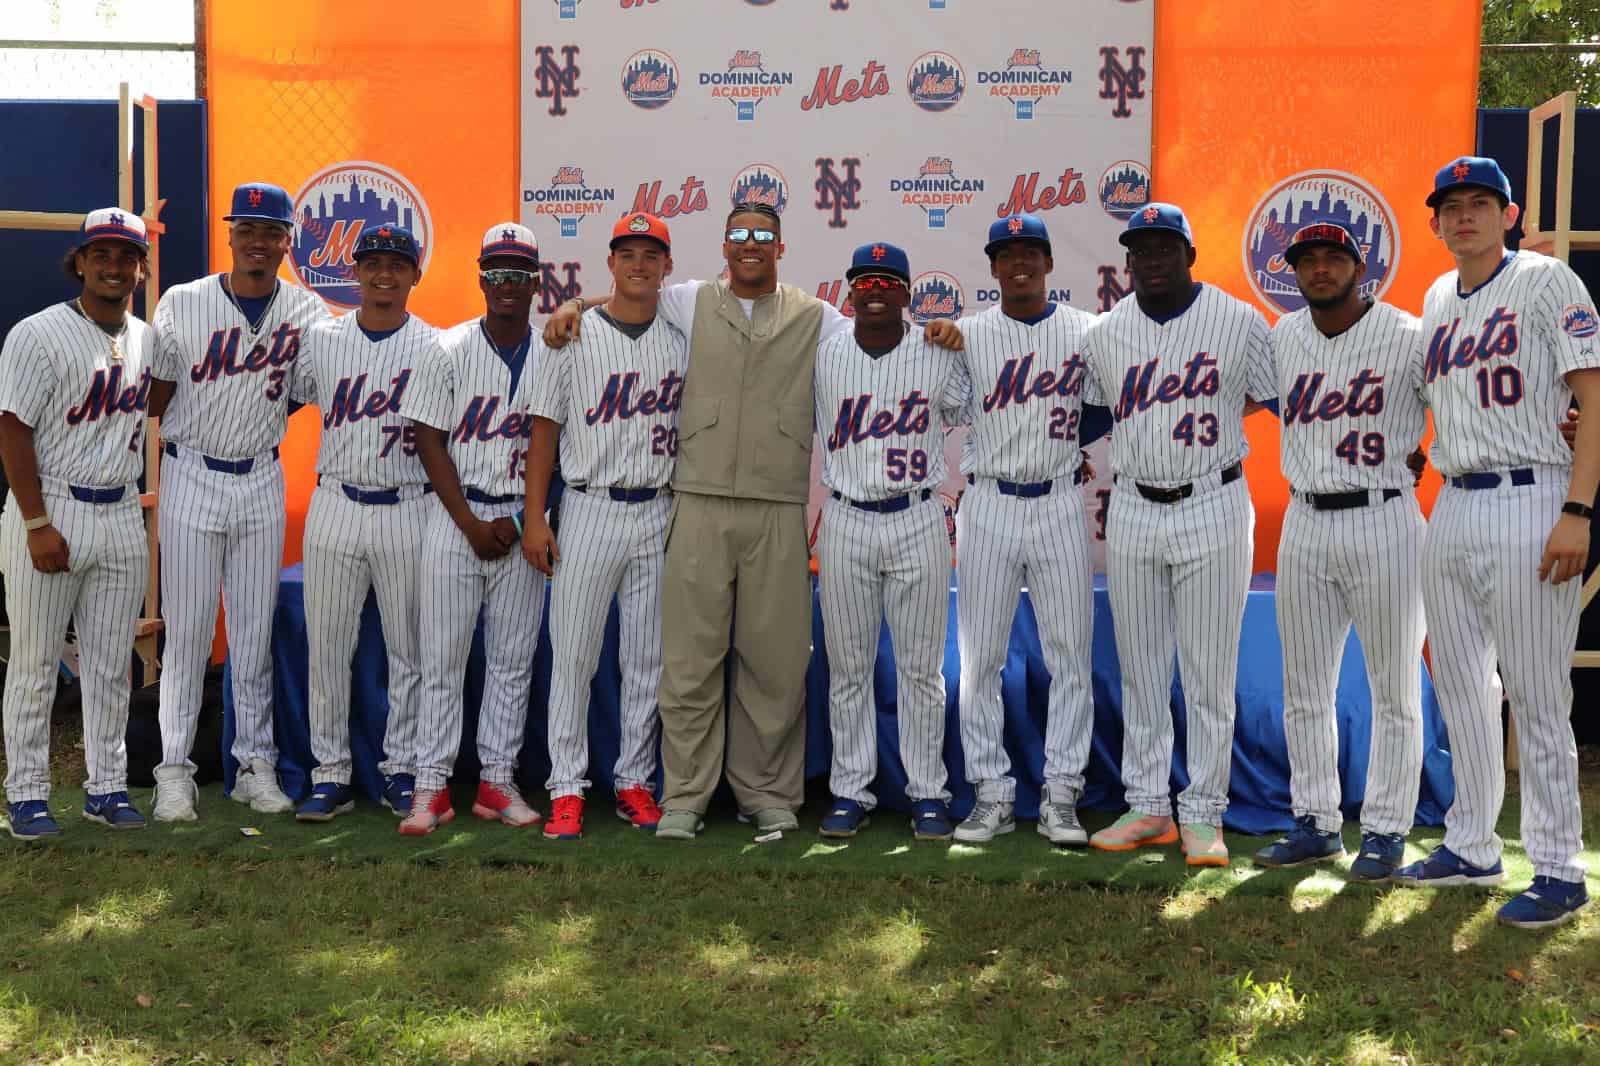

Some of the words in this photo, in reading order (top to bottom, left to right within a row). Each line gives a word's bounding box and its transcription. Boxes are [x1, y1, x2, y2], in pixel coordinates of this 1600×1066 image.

[699, 72, 793, 85] DOMINICAN
[711, 86, 782, 98] ACADEMY
[800, 61, 890, 111] Mets
[977, 70, 1072, 84] DOMINICAN
[989, 85, 1062, 97] ACADEMY
[523, 188, 615, 202] DOMINICAN
[620, 176, 709, 218] Mets
[890, 179, 984, 192] DOMINICAN
[902, 193, 973, 205] ACADEMY
[997, 168, 1086, 217] Mets
[535, 202, 604, 215] ACADEMY
[191, 322, 301, 383] Mets
[1425, 307, 1518, 384] Mets
[66, 364, 152, 425] Met
[266, 370, 287, 404] 3
[324, 368, 413, 431] Met
[1114, 352, 1219, 424] Mets
[1284, 369, 1384, 427] Mets
[1476, 365, 1524, 409] 10
[827, 390, 930, 452] Mets
[1049, 407, 1080, 441] 22
[1173, 412, 1219, 447] 43
[379, 426, 417, 458] 75
[652, 424, 679, 458] 20
[1335, 430, 1385, 466] 49
[885, 447, 928, 482] 59
